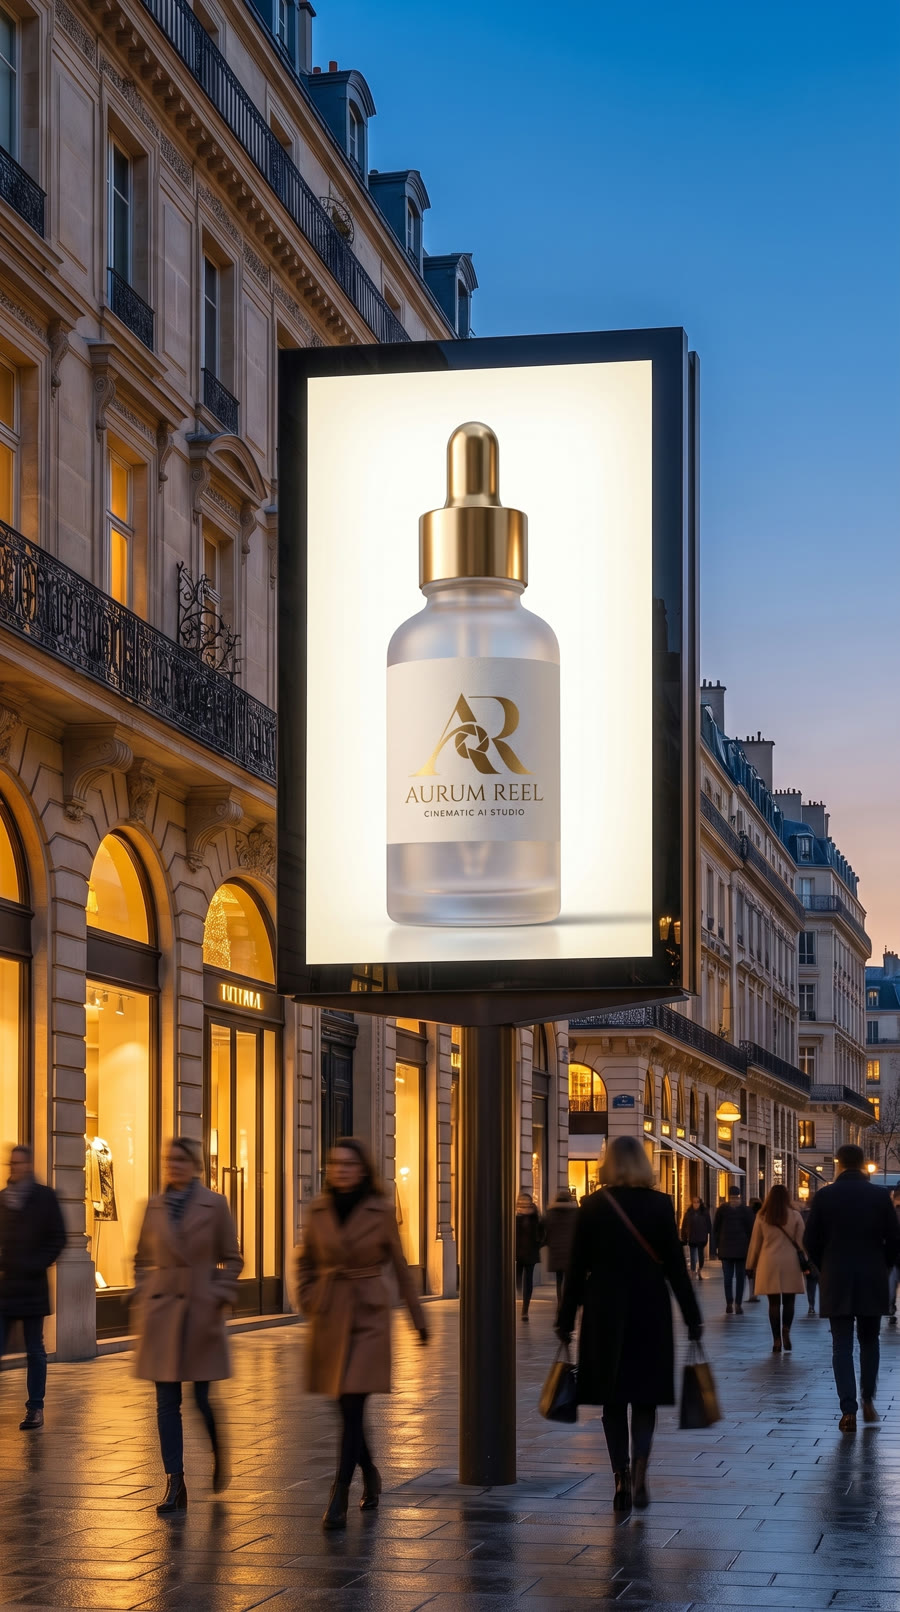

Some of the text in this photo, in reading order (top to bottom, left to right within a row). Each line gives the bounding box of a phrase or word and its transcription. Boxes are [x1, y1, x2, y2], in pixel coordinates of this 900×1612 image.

[405, 783, 544, 804] AURUM REEL
[423, 808, 525, 818] CINEMATIC AI STUDIO
